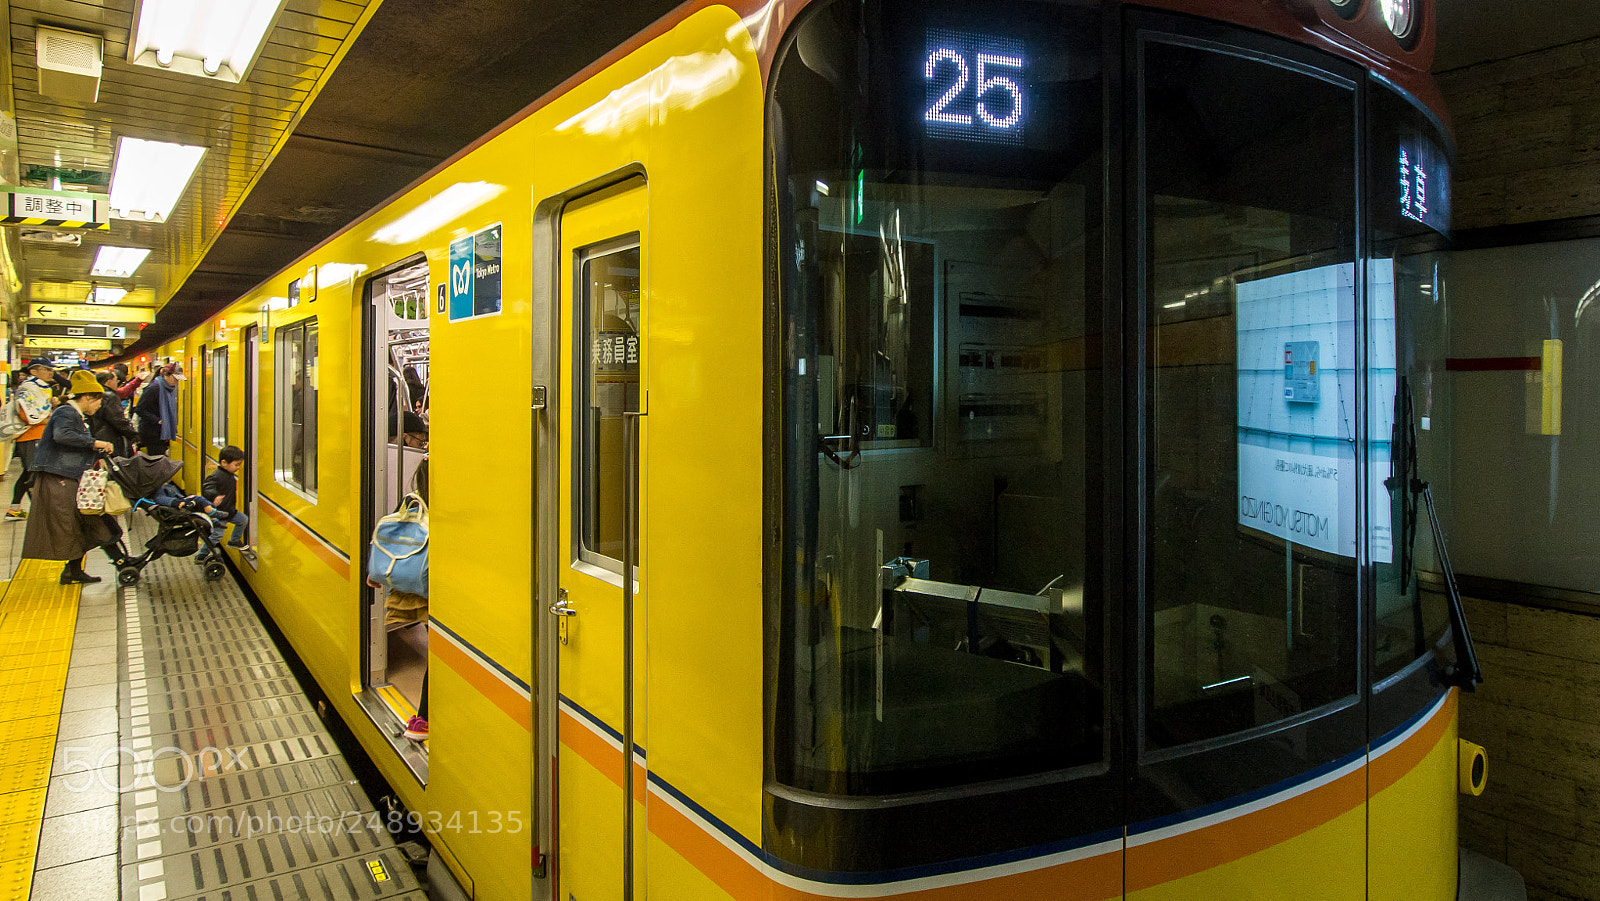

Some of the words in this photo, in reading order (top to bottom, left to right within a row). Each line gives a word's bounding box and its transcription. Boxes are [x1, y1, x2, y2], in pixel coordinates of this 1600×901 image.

[925, 48, 1022, 128] 25
[25, 197, 82, 215] 調整中
[475, 267, 487, 280] Tokyo
[487, 263, 500, 276] Metro
[439, 286, 445, 311] 6
[112, 327, 121, 338] 2
[592, 335, 638, 364] 乗務員室
